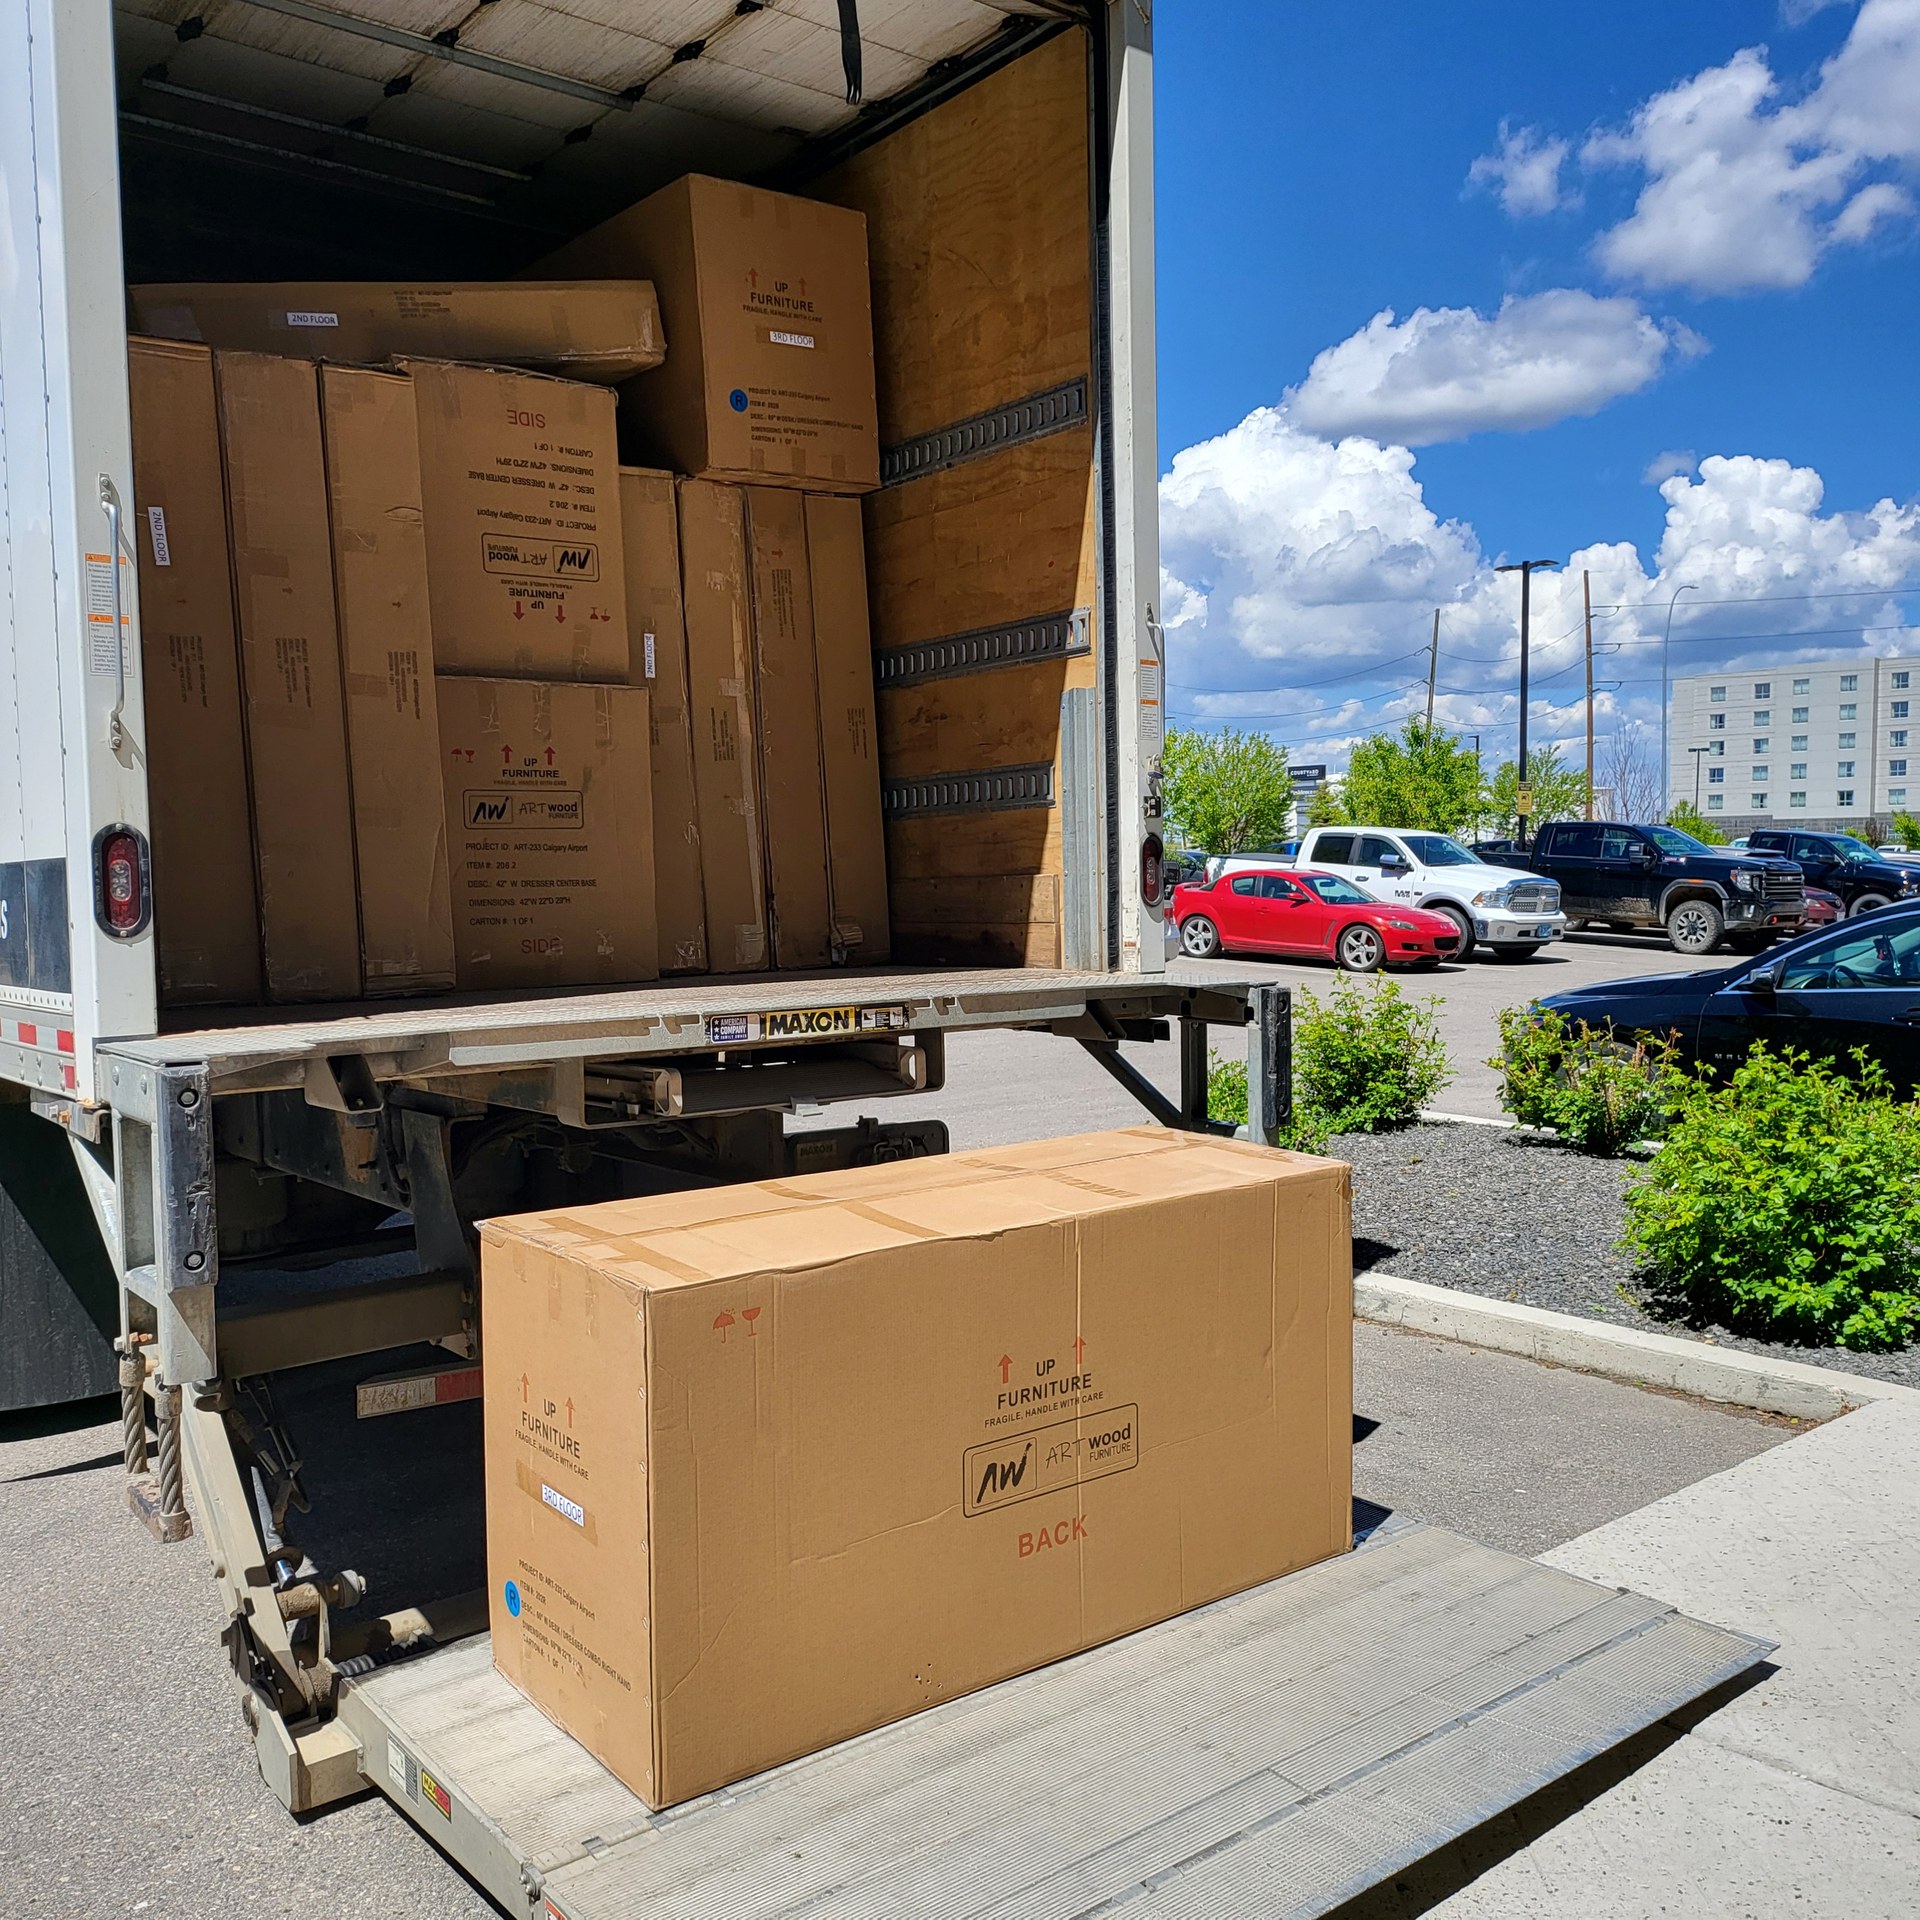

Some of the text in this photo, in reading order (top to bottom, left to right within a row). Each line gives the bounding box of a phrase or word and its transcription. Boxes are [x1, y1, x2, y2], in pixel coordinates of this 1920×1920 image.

[775, 281, 788, 292] UP
[750, 292, 814, 312] FURNITURE
[292, 314, 336, 325] 2ND FLOOR
[770, 309, 792, 319] HANDLE
[772, 332, 814, 346] 3RD FLOOR
[735, 395, 743, 406] R
[506, 409, 546, 429] SIDE
[540, 443, 549, 451] OF
[565, 447, 593, 458] CARTON
[468, 471, 485, 481] BASE
[485, 473, 511, 484] CENTER
[513, 477, 546, 488] DRESSER
[477, 508, 499, 519] Airport
[579, 504, 596, 513] ITEM
[500, 510, 523, 522] Calgary
[525, 514, 552, 526] ART-233
[565, 521, 597, 531] PROJECT
[153, 512, 167, 562] 2ND FLOOR
[487, 543, 518, 553] FURNITURE
[509, 587, 564, 600] FURNITURE
[531, 600, 544, 610] UP
[524, 758, 538, 767] UP
[502, 769, 560, 778] FURNITURE
[465, 843, 499, 851] PROJECT
[514, 843, 541, 851] ART-233
[543, 843, 566, 853] Calgary
[567, 844, 588, 852] Airport
[581, 879, 598, 887] BASE
[469, 917, 501, 926] CARTON
[518, 917, 529, 925] OF
[521, 936, 562, 954] SIDE
[720, 1016, 747, 1026] AMERICAN
[768, 1009, 850, 1036] MAXON
[720, 1025, 747, 1035] COMPANY
[800, 1143, 833, 1156] MAXON
[1036, 1358, 1055, 1376] UP
[997, 1373, 1092, 1409] FURNITURE
[544, 1398, 556, 1418] UP
[984, 1391, 1104, 1428] FRAGILE, HANDLE WITH CARE
[522, 1411, 580, 1459] FURNITURE
[515, 1429, 589, 1480] FRAGILE, HANDLE WITH CARE
[1089, 1441, 1131, 1462] FURNITURE
[544, 1487, 583, 1525] 3RD FLOOR
[1018, 1514, 1088, 1558] BACK
[519, 1559, 538, 1579] PROJECT
[563, 1589, 579, 1610] Calgary
[579, 1602, 596, 1621] Airport
[520, 1580, 530, 1593] ITEM
[509, 1589, 517, 1608] R
[563, 1630, 583, 1653] DRESSER
[584, 1647, 601, 1667] COMBO
[602, 1660, 616, 1680] RIGHT
[616, 1673, 631, 1691] HAND
